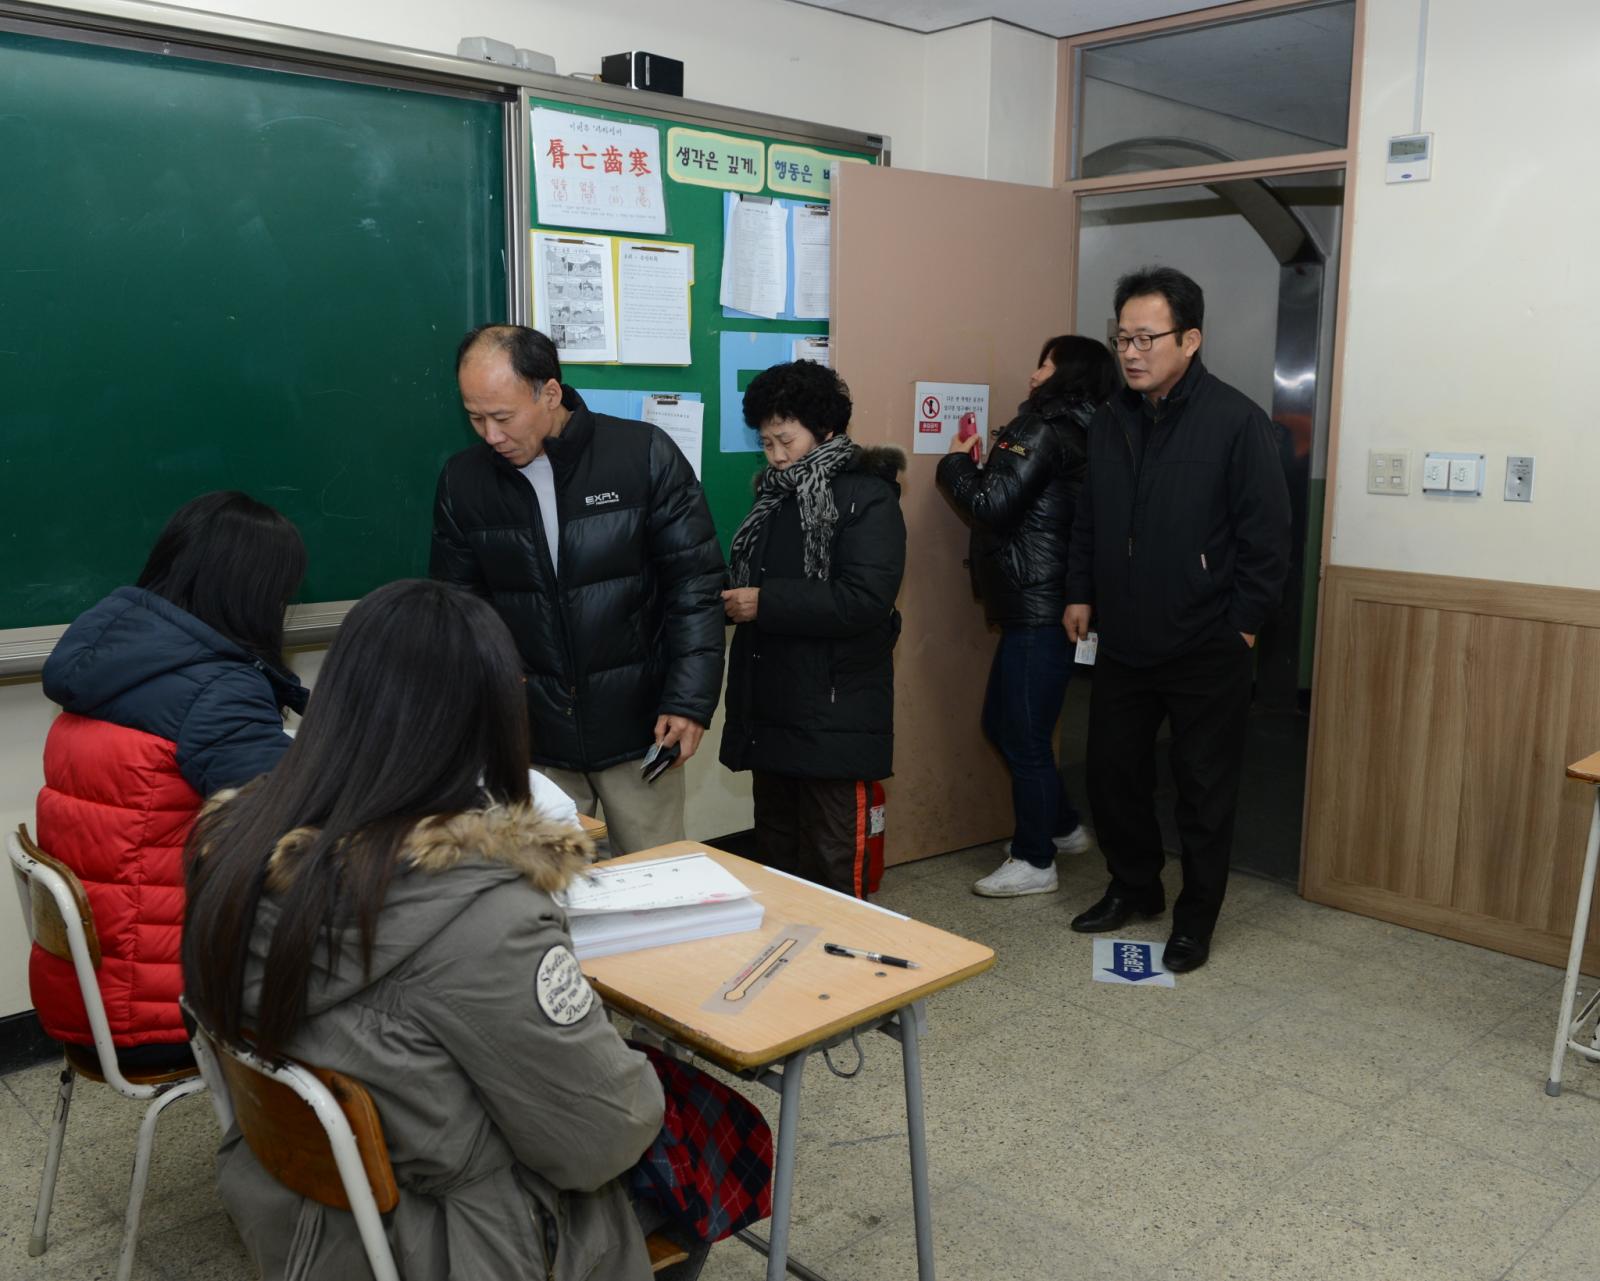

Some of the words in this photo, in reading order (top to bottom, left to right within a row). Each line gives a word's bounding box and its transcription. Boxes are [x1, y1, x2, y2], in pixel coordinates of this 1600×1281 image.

[676, 146, 719, 171] 생각은
[727, 154, 757, 176] 깊게,
[774, 159, 813, 183] 행동은
